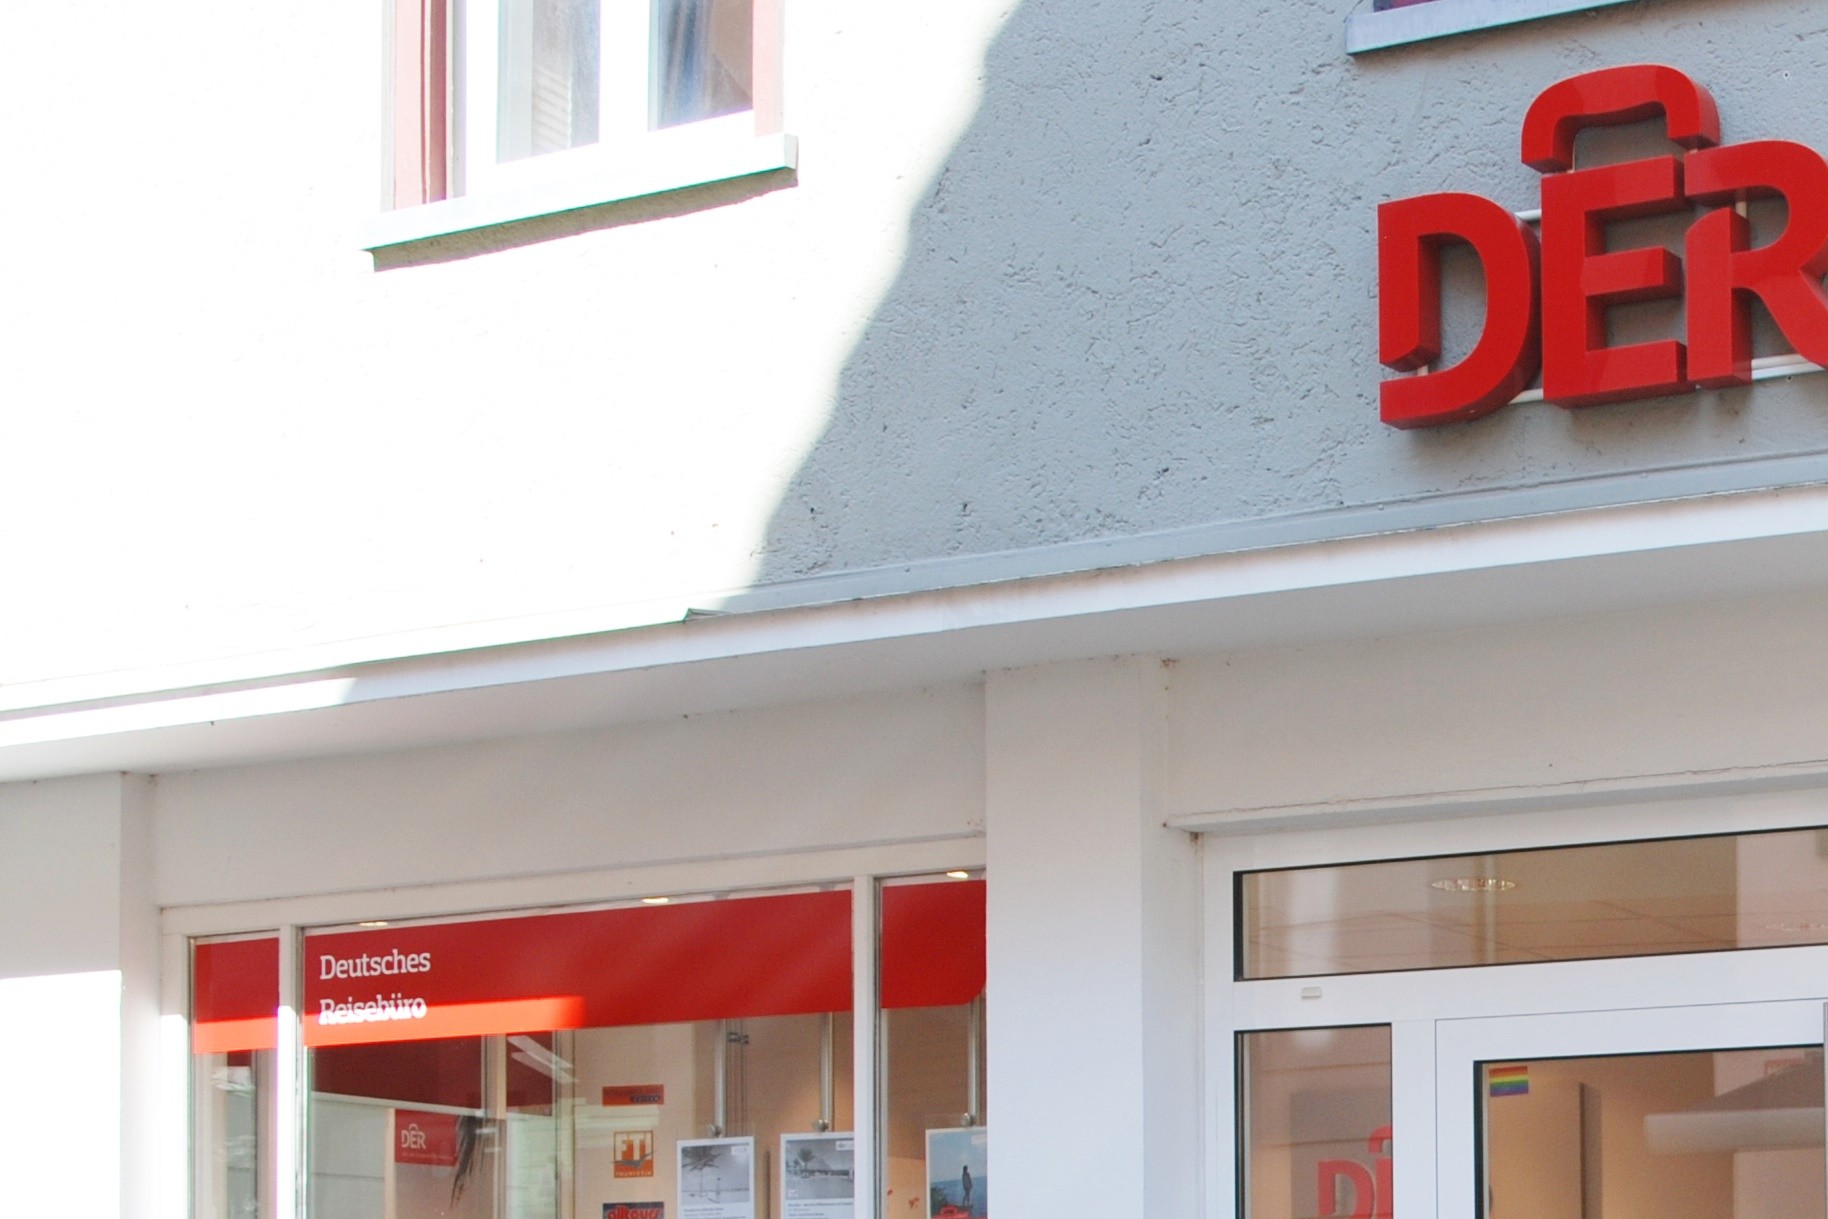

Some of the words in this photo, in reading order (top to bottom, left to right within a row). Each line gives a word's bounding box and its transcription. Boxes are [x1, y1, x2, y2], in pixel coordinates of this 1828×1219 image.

[320, 948, 431, 980] Deutsches
[318, 993, 427, 1025] Reisebüro
[401, 1126, 427, 1149] DER
